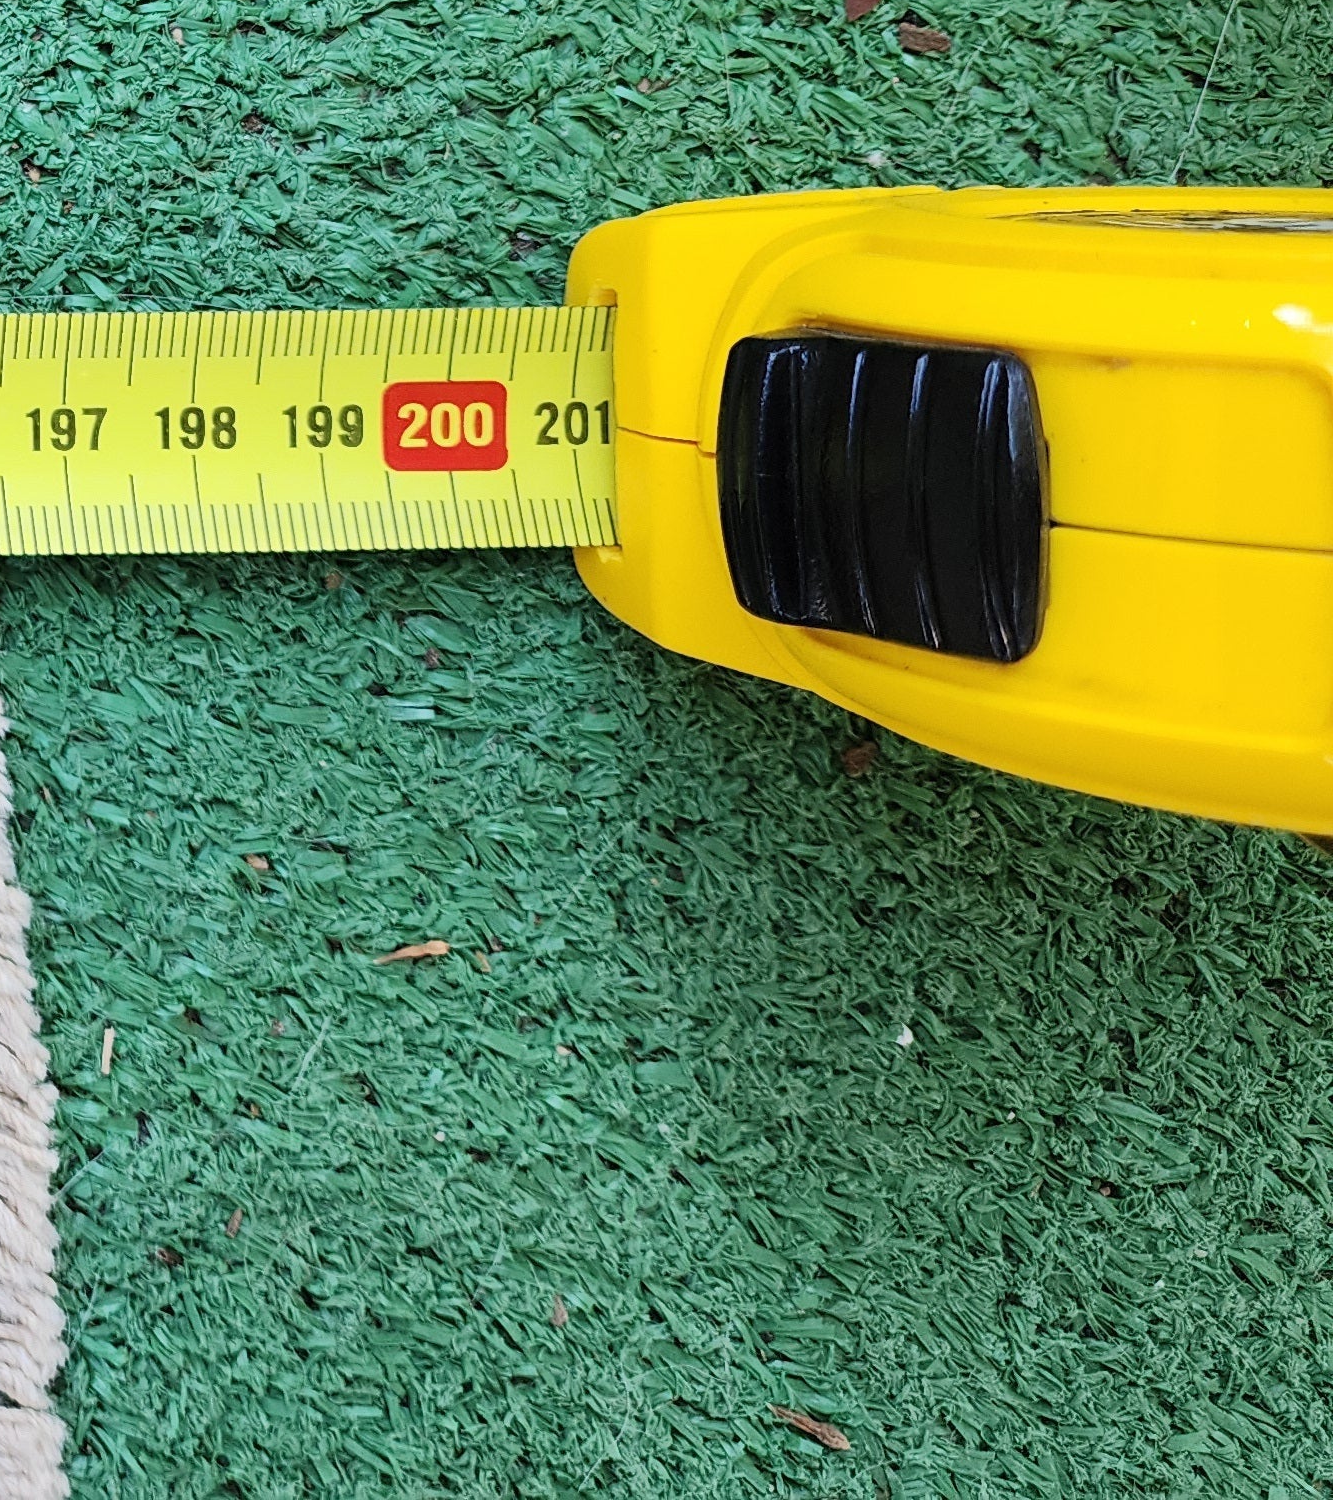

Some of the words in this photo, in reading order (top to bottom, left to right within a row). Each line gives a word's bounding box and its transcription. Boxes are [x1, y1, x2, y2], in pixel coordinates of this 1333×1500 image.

[26, 407, 108, 451] 197
[154, 405, 238, 450] 198
[282, 404, 364, 448] 199
[397, 403, 495, 448] 200
[535, 401, 609, 446] 201
